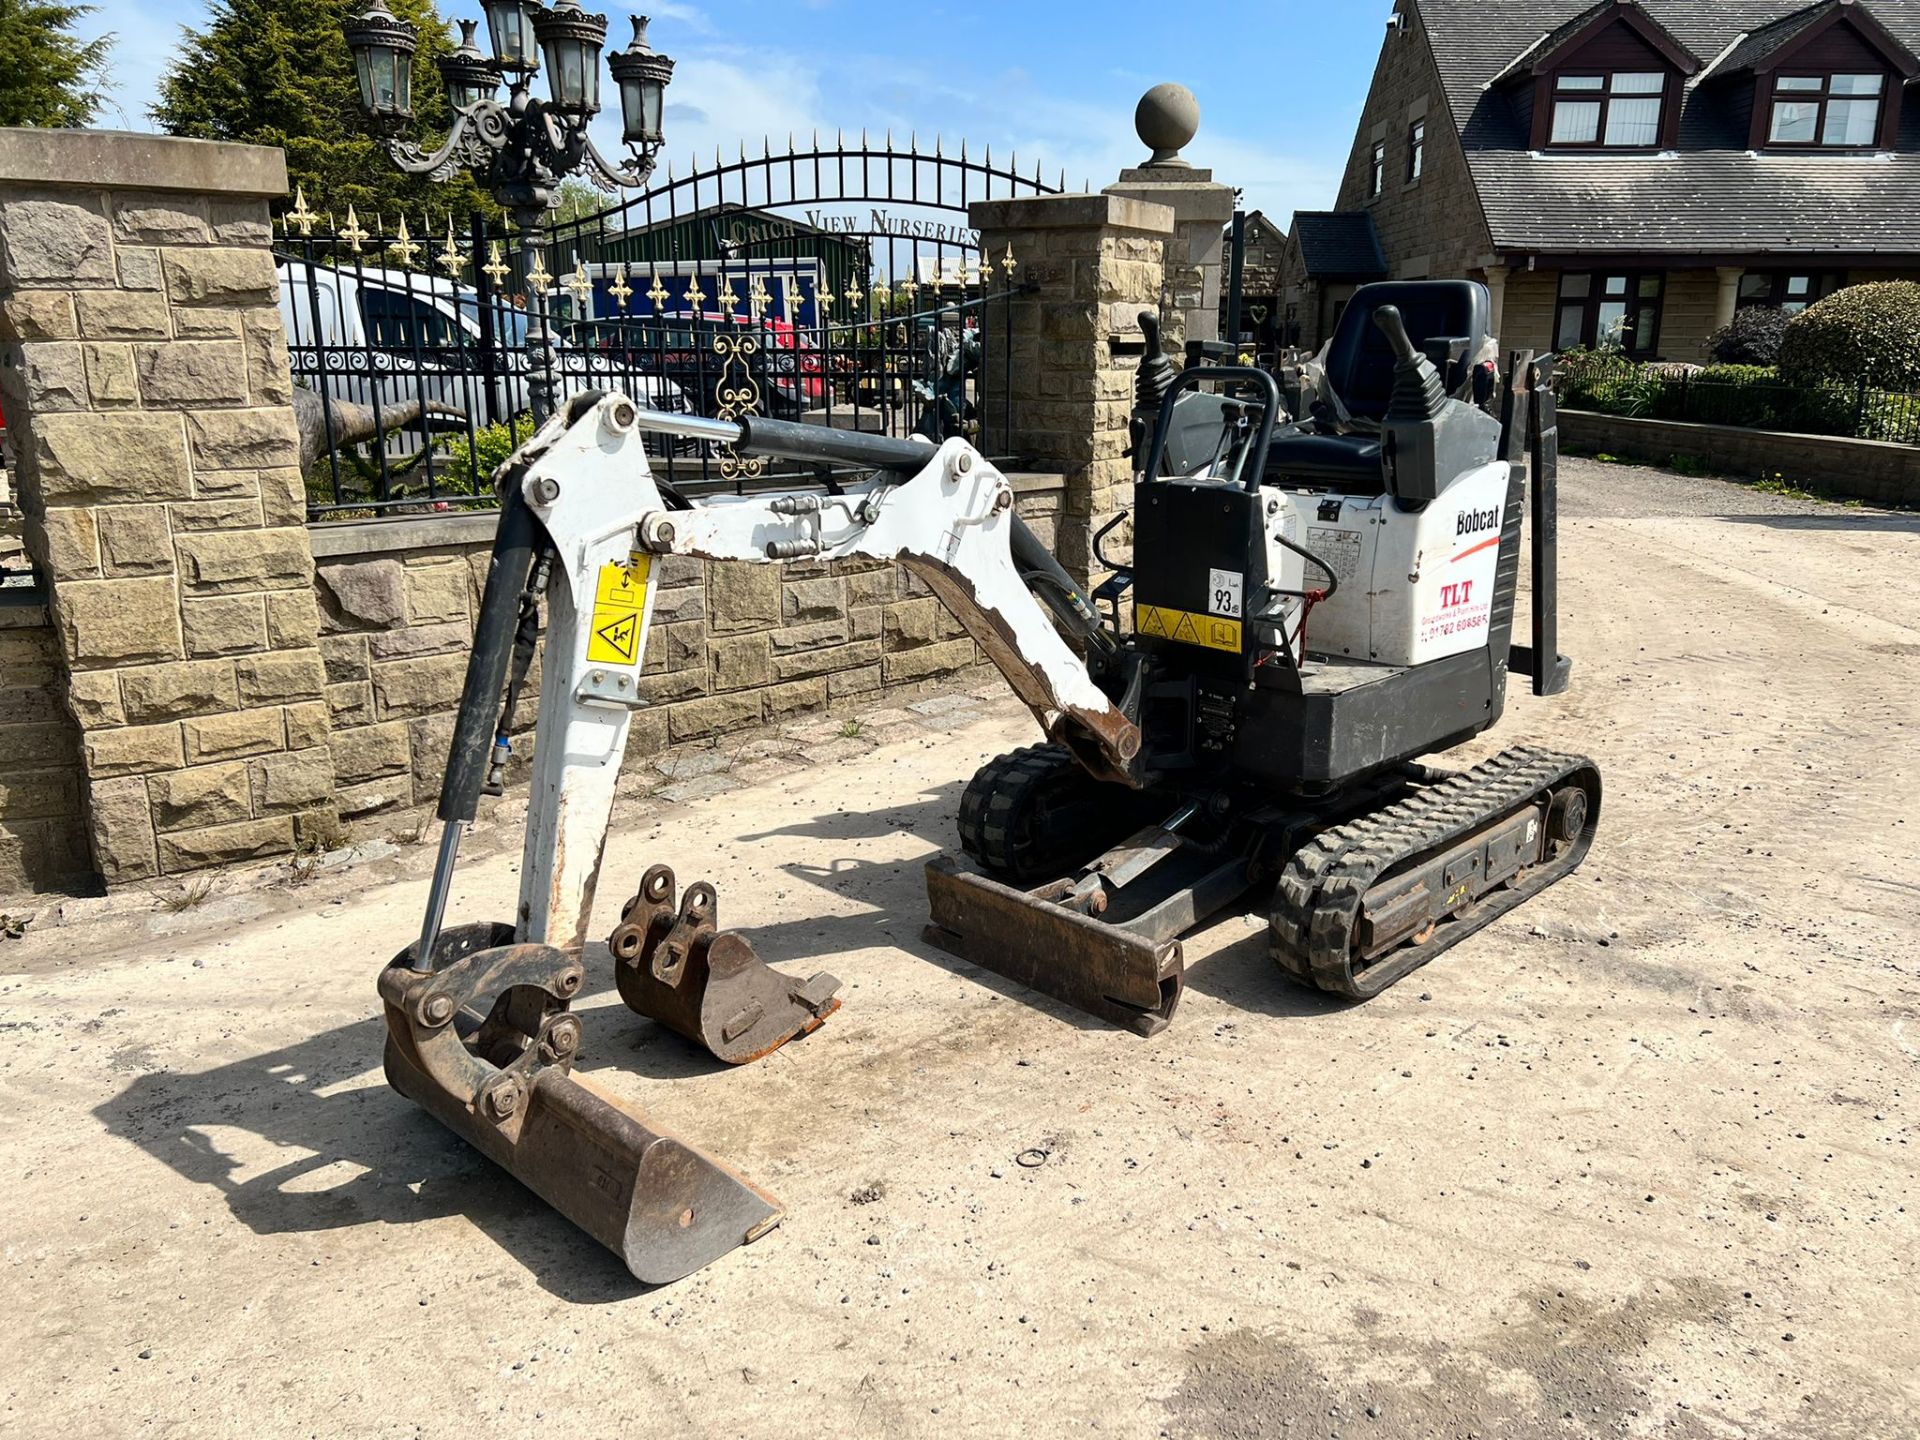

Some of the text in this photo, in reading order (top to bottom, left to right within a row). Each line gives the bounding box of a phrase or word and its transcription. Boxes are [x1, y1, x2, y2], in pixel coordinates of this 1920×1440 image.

[805, 209, 857, 234] VIEW
[870, 208, 981, 246] NURSERIES
[1456, 505, 1499, 536] Bobcat
[1215, 589, 1231, 612] 93
[1440, 580, 1472, 609] TLT
